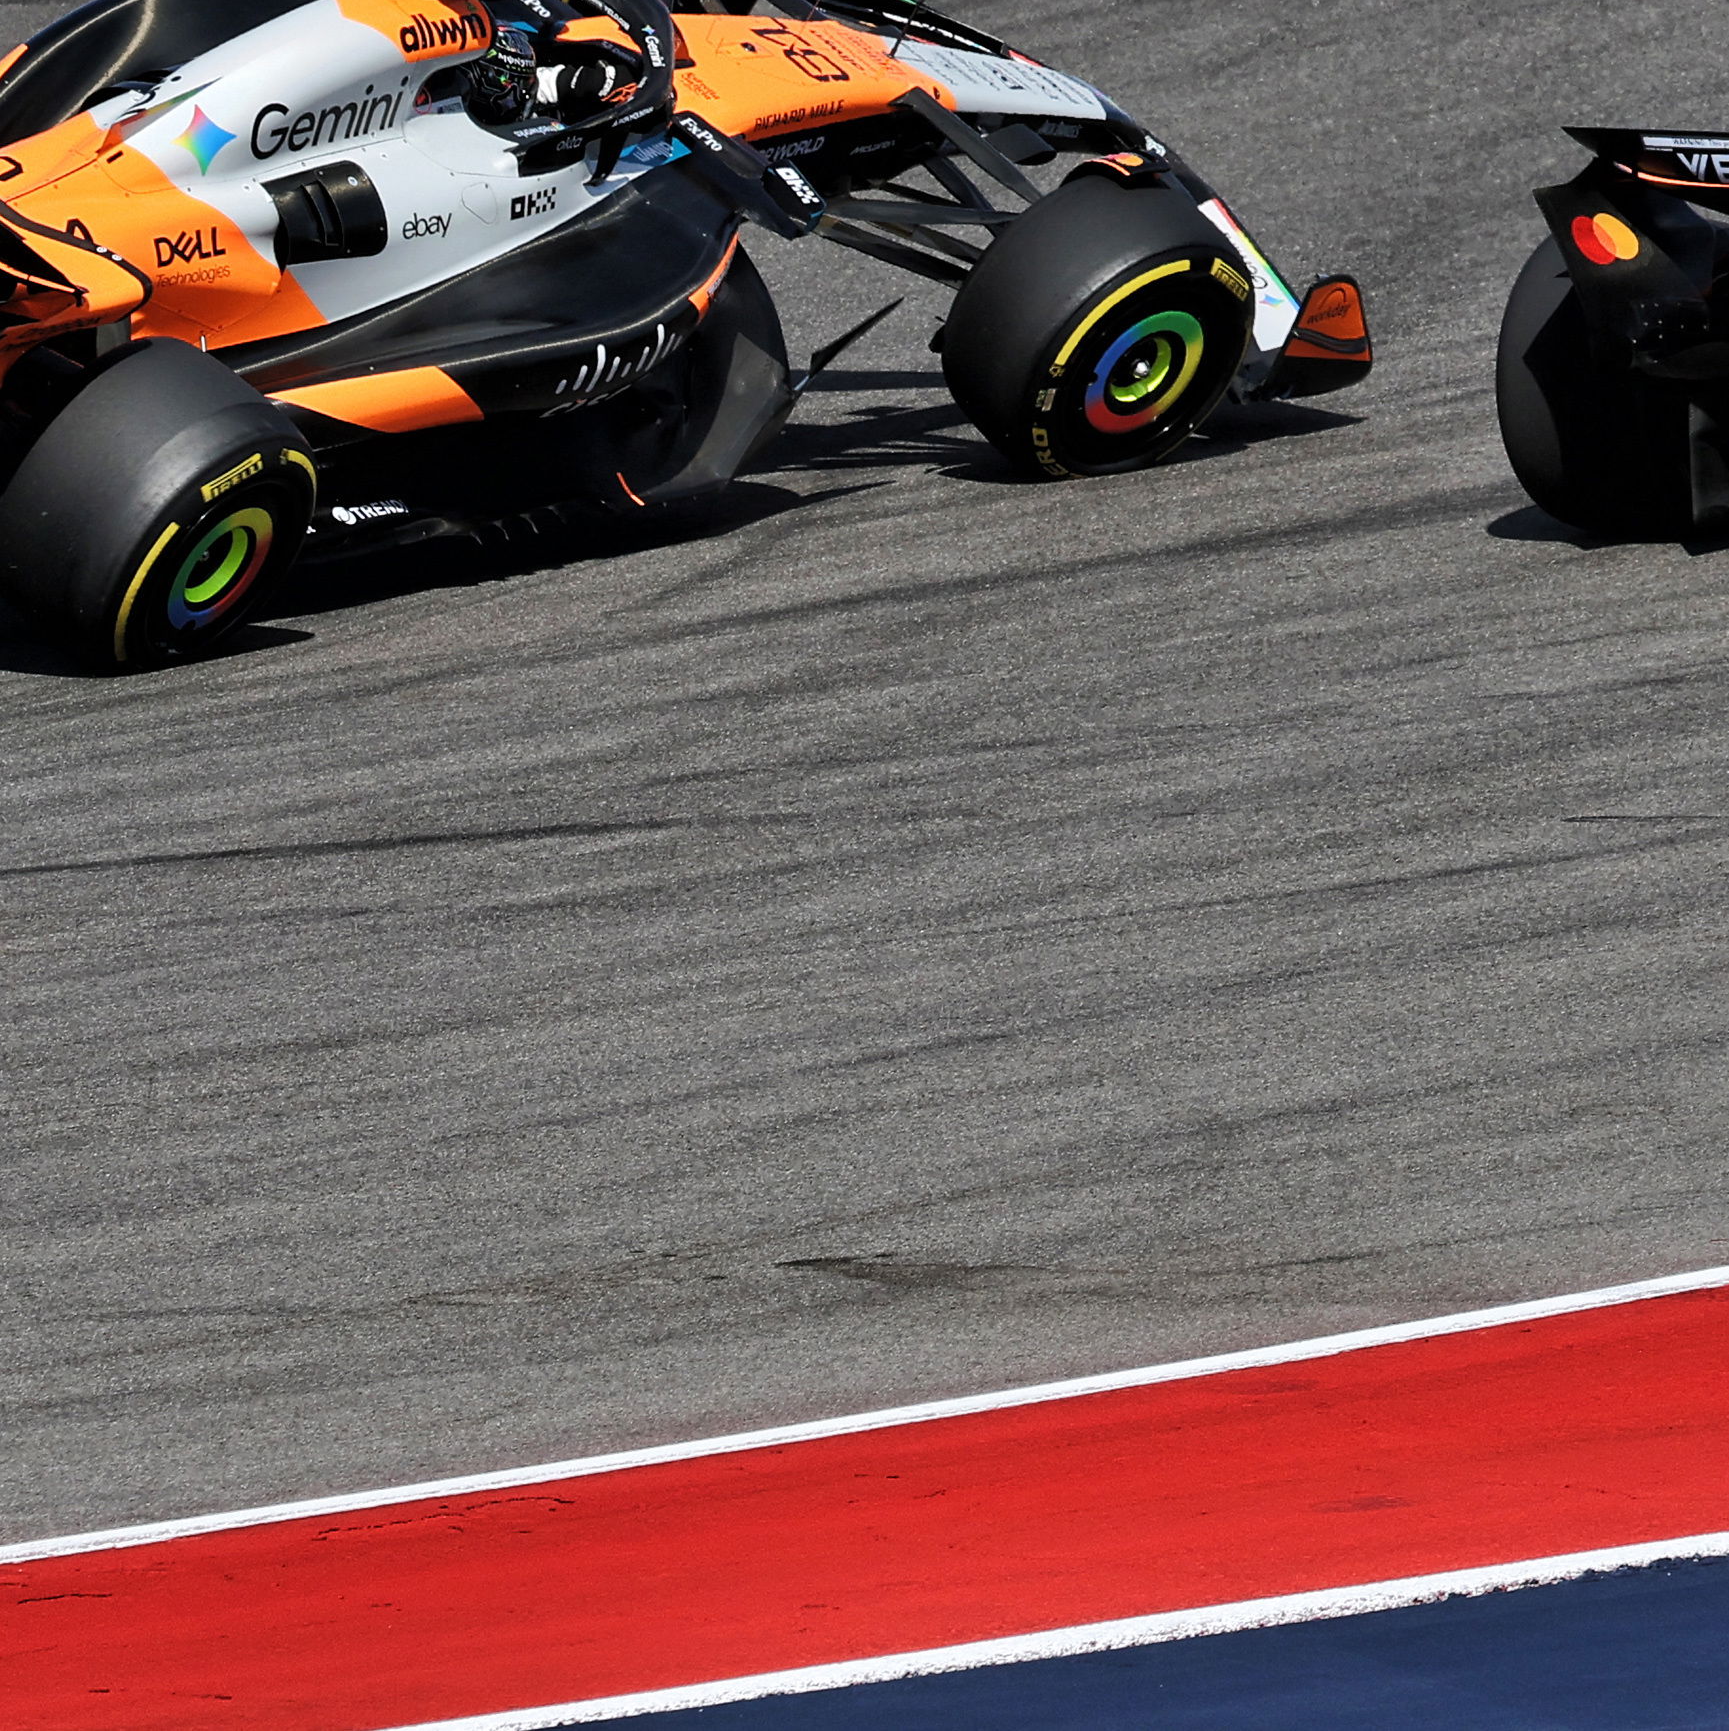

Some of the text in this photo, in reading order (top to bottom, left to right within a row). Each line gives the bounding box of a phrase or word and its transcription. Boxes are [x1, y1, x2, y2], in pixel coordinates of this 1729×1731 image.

[399, 12, 487, 55] allwyn
[644, 35, 666, 68] Gemini
[250, 74, 410, 161] Gemini
[754, 99, 845, 132] RICHARD MILLE
[556, 137, 583, 152] okta
[679, 118, 722, 152] FxPro
[773, 136, 825, 160] WORLD
[401, 211, 453, 241] ebay
[153, 226, 227, 269] DELL
[155, 264, 231, 288] Technologies
[1209, 256, 1250, 302] PIRELLI
[200, 453, 264, 503] PIRELLI
